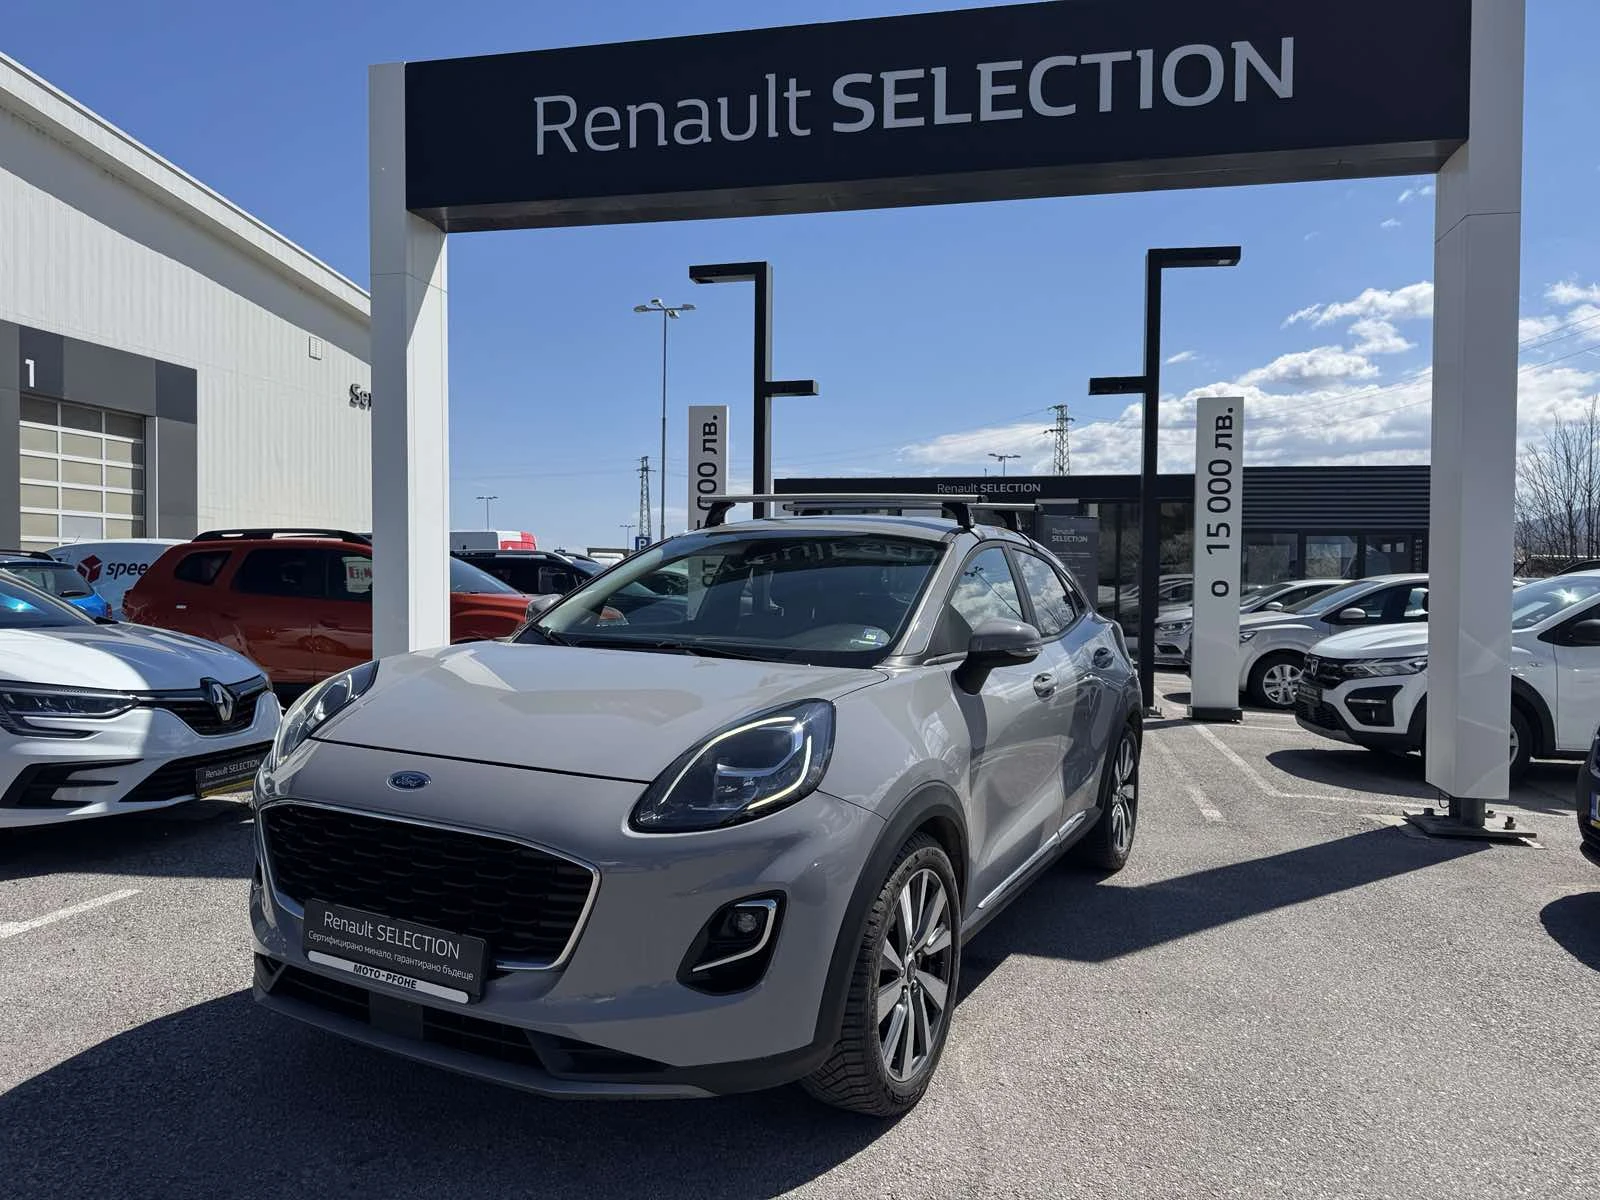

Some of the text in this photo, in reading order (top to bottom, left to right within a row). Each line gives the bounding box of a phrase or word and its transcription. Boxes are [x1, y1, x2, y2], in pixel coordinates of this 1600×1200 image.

[533, 36, 1295, 156] Renault SELECTION
[24, 358, 35, 387] 1
[702, 415, 718, 454] лв.
[1214, 407, 1234, 451] лв.
[937, 482, 1041, 493] Renault SELECTION
[1207, 459, 1233, 514] 000
[1206, 522, 1231, 555] 15
[308, 929, 474, 981] Сертифицирано минало, гарантирано бъдеще
[324, 911, 461, 960] Renault SELECTION
